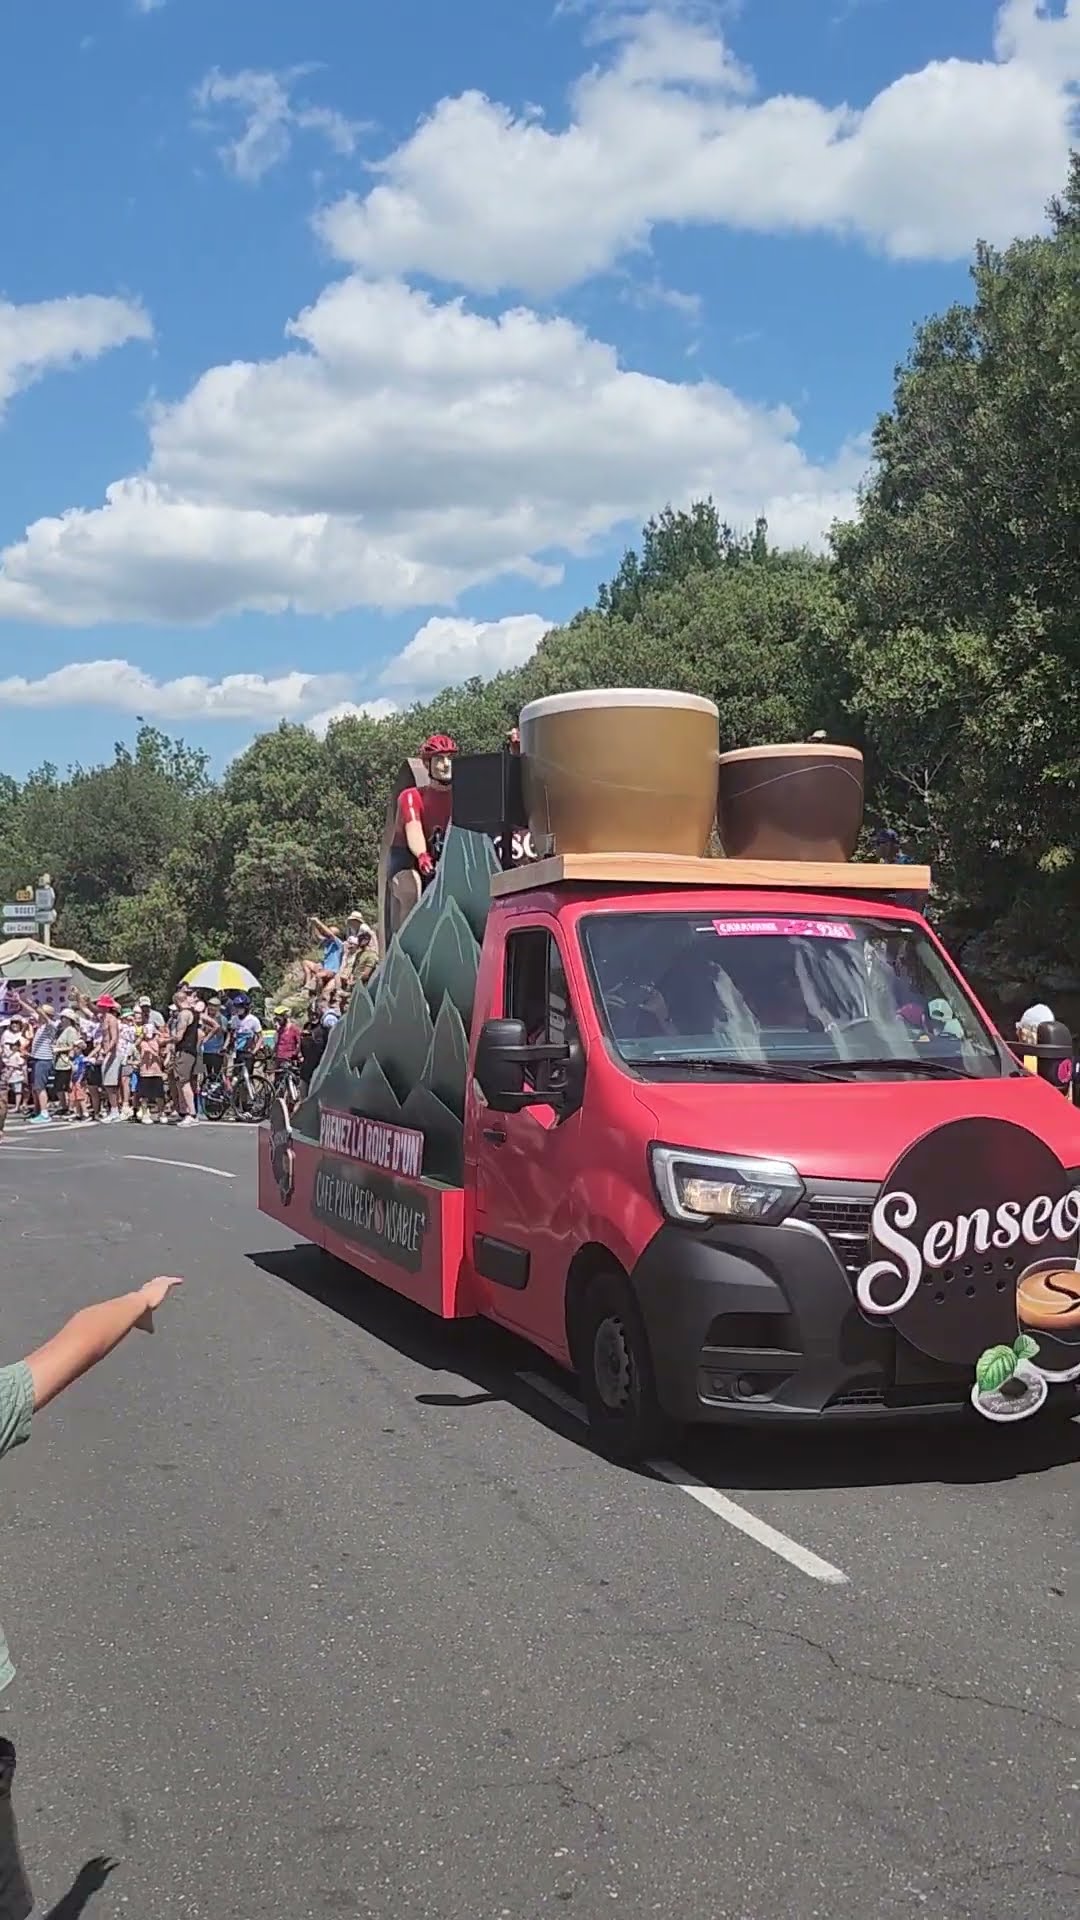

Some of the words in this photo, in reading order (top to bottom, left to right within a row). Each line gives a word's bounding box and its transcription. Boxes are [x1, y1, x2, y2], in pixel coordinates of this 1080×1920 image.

[320, 1113, 351, 1154] PRENEZ
[364, 1124, 392, 1168] ROUE
[391, 1131, 420, 1177] D'UN
[316, 1171, 335, 1212] CAFÉ
[334, 1179, 354, 1221] PLUS
[856, 1190, 1080, 1315] Senseo
